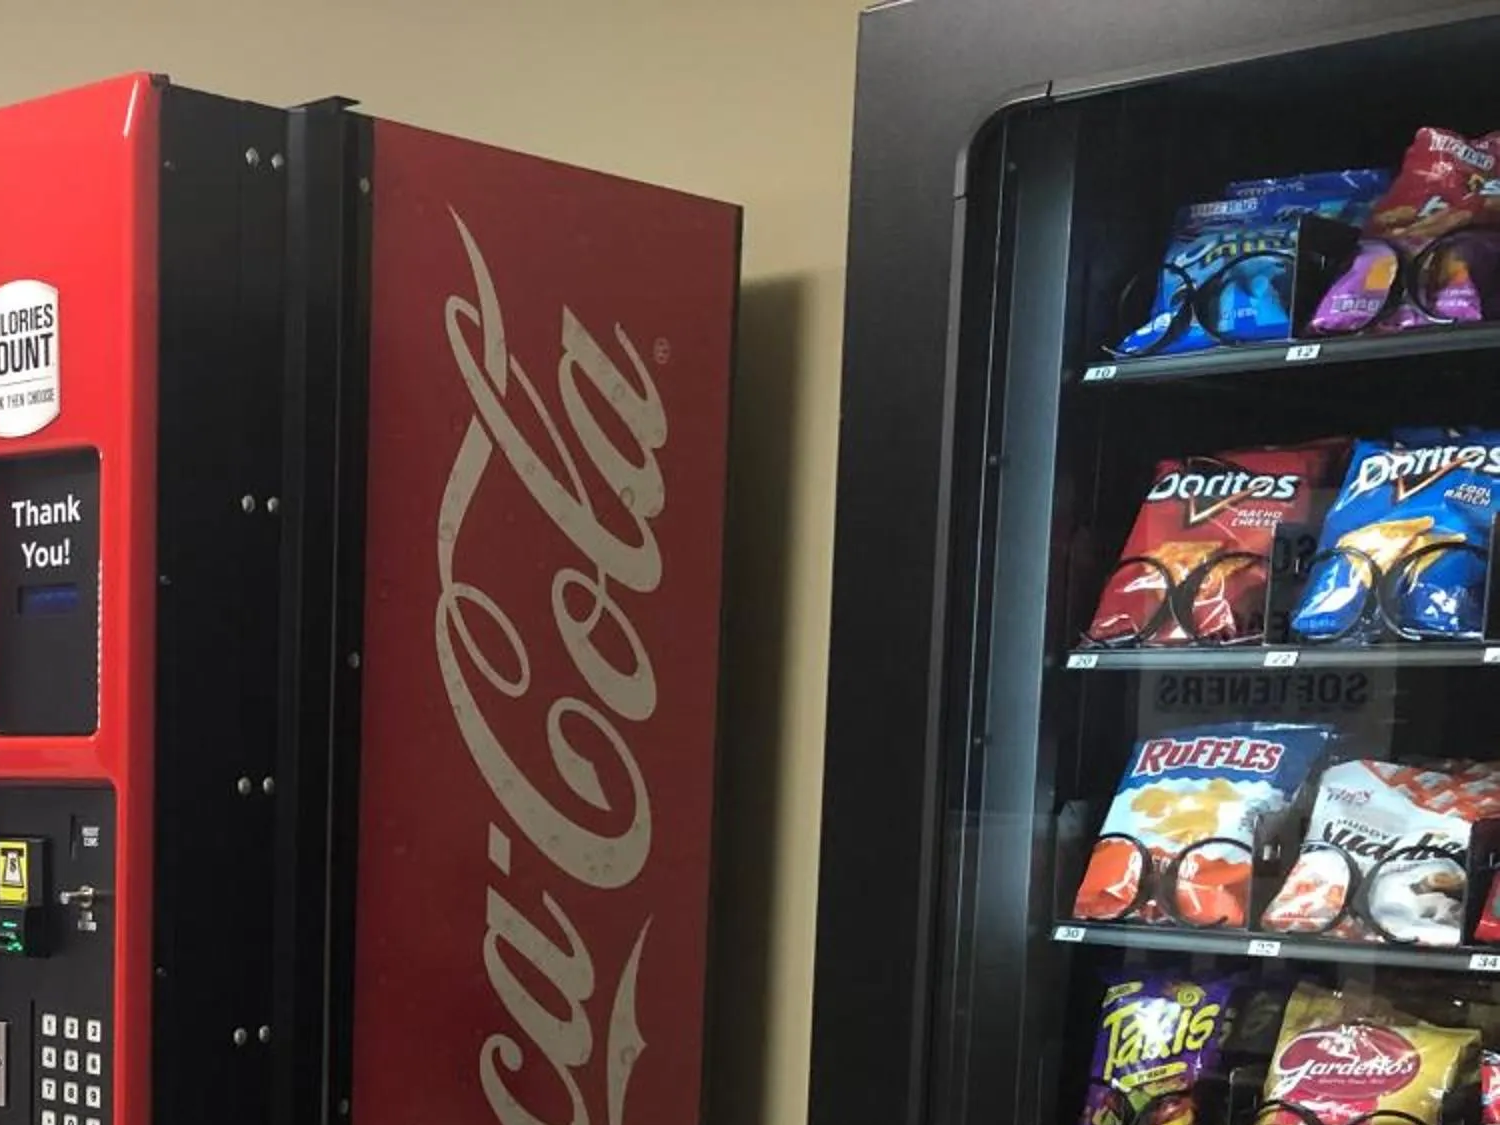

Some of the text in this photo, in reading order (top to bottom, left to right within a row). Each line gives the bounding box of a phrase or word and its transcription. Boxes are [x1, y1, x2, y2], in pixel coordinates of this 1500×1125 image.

[1147, 471, 1300, 500] Doritos
[11, 494, 81, 528] Thank
[21, 538, 70, 569] You!
